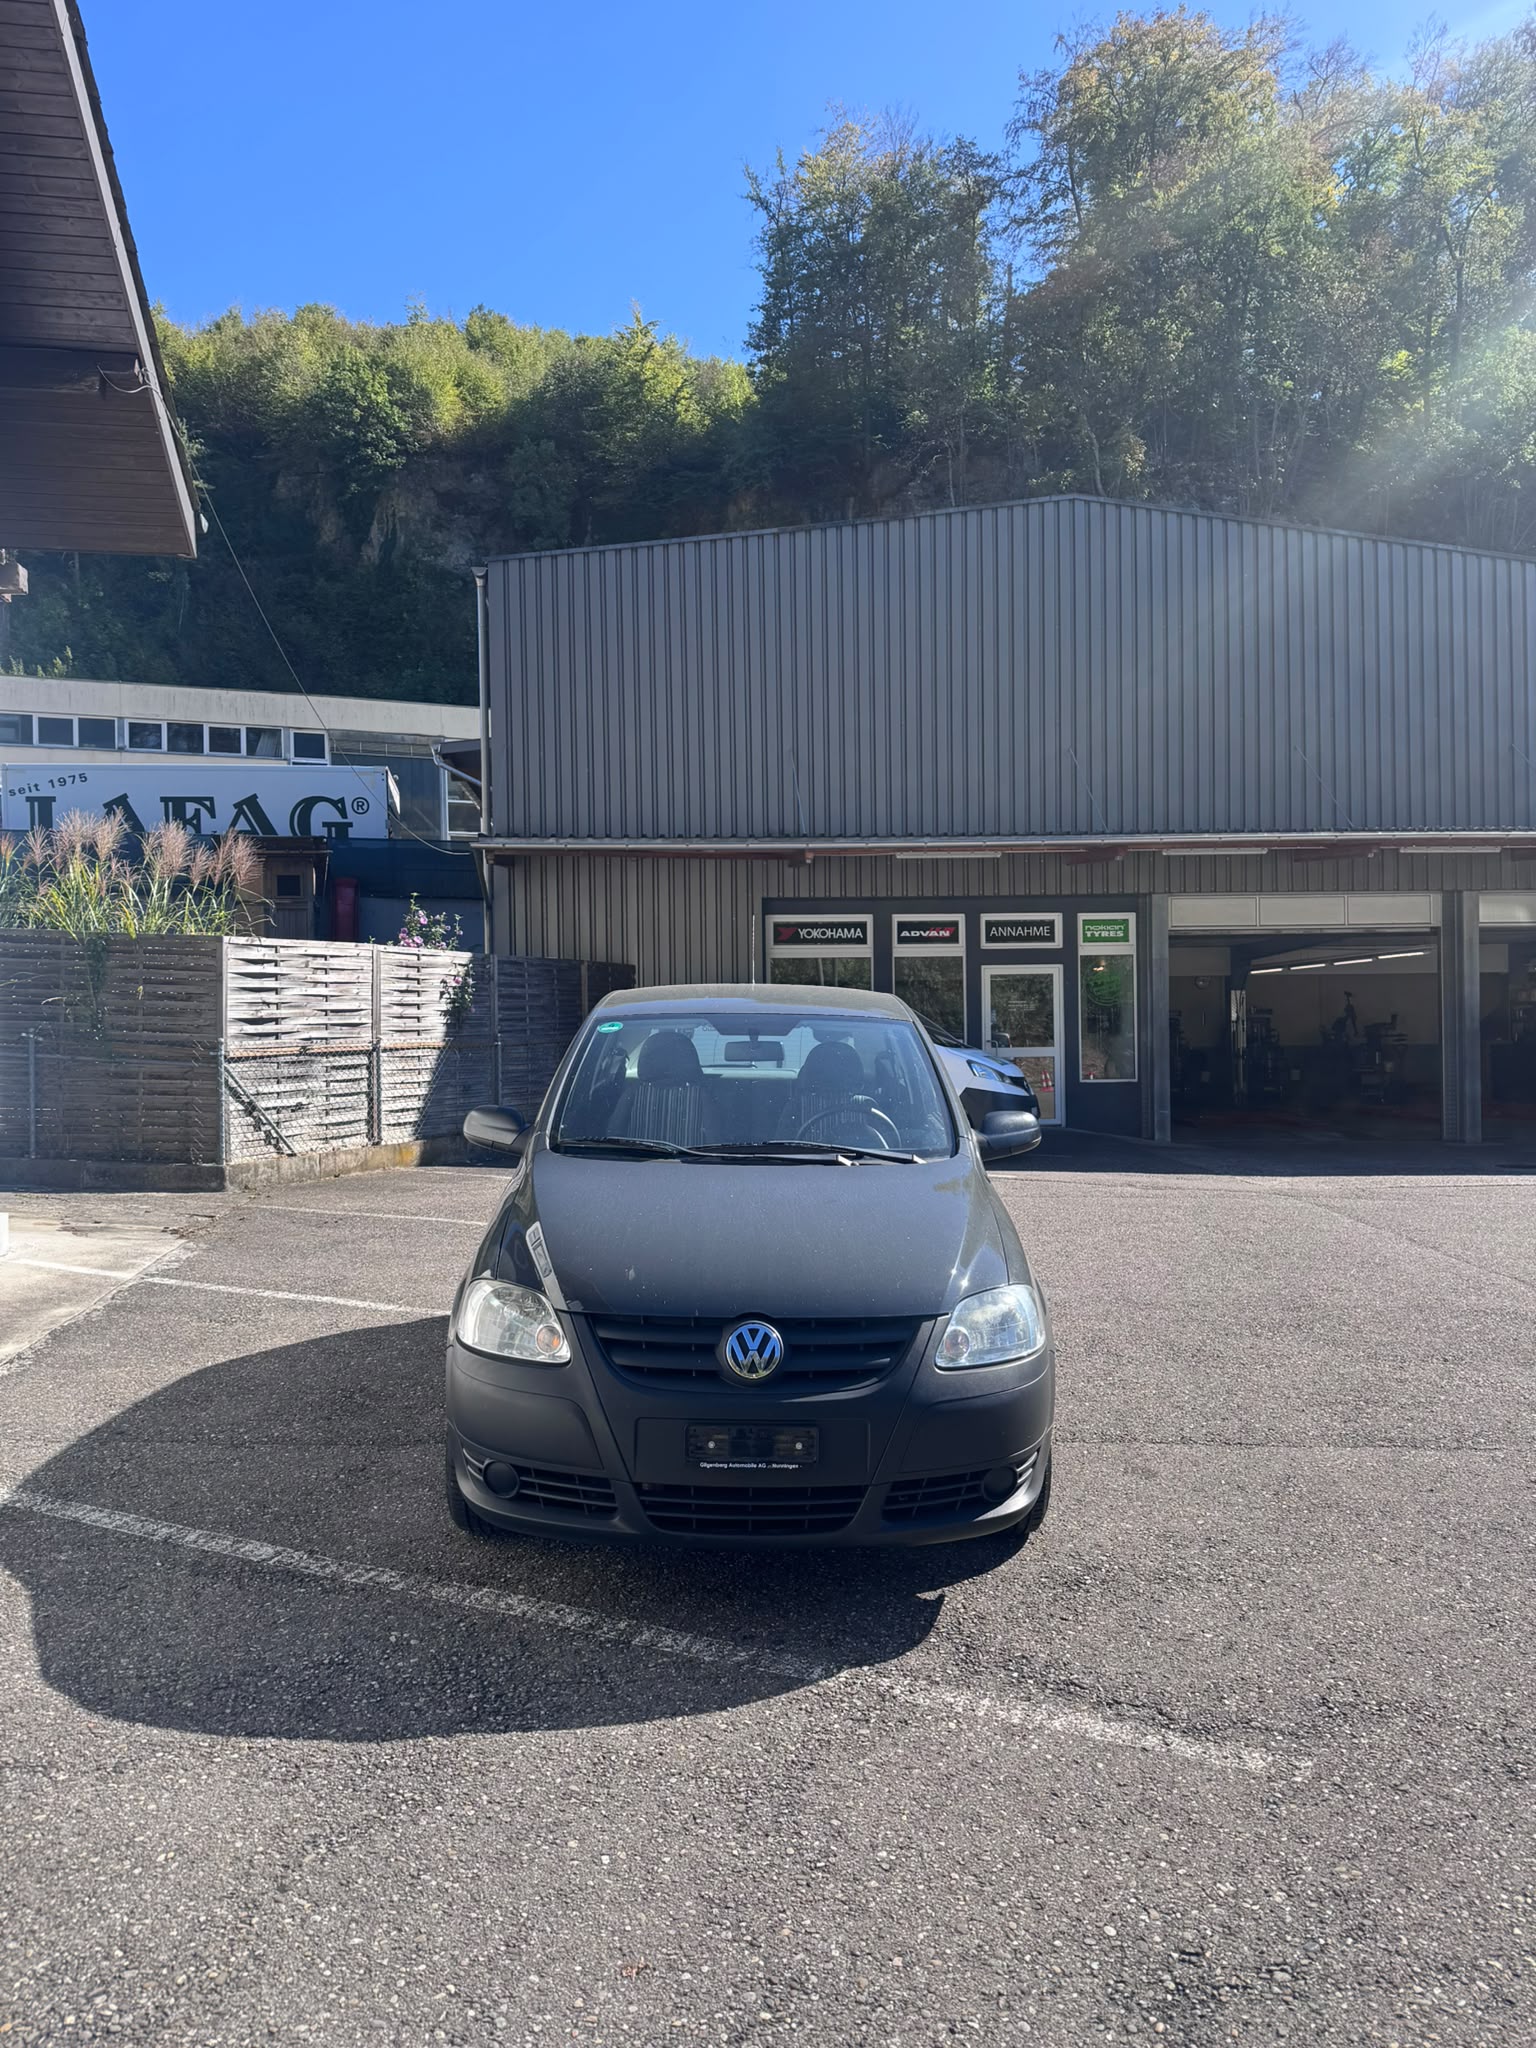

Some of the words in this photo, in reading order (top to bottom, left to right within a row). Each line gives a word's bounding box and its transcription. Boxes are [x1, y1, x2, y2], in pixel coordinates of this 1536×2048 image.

[8, 782, 41, 797] seit
[48, 772, 88, 789] 1975
[798, 928, 863, 939] YOKOHAMA
[989, 926, 1051, 937] ANNAHME
[726, 1320, 784, 1379] VW
